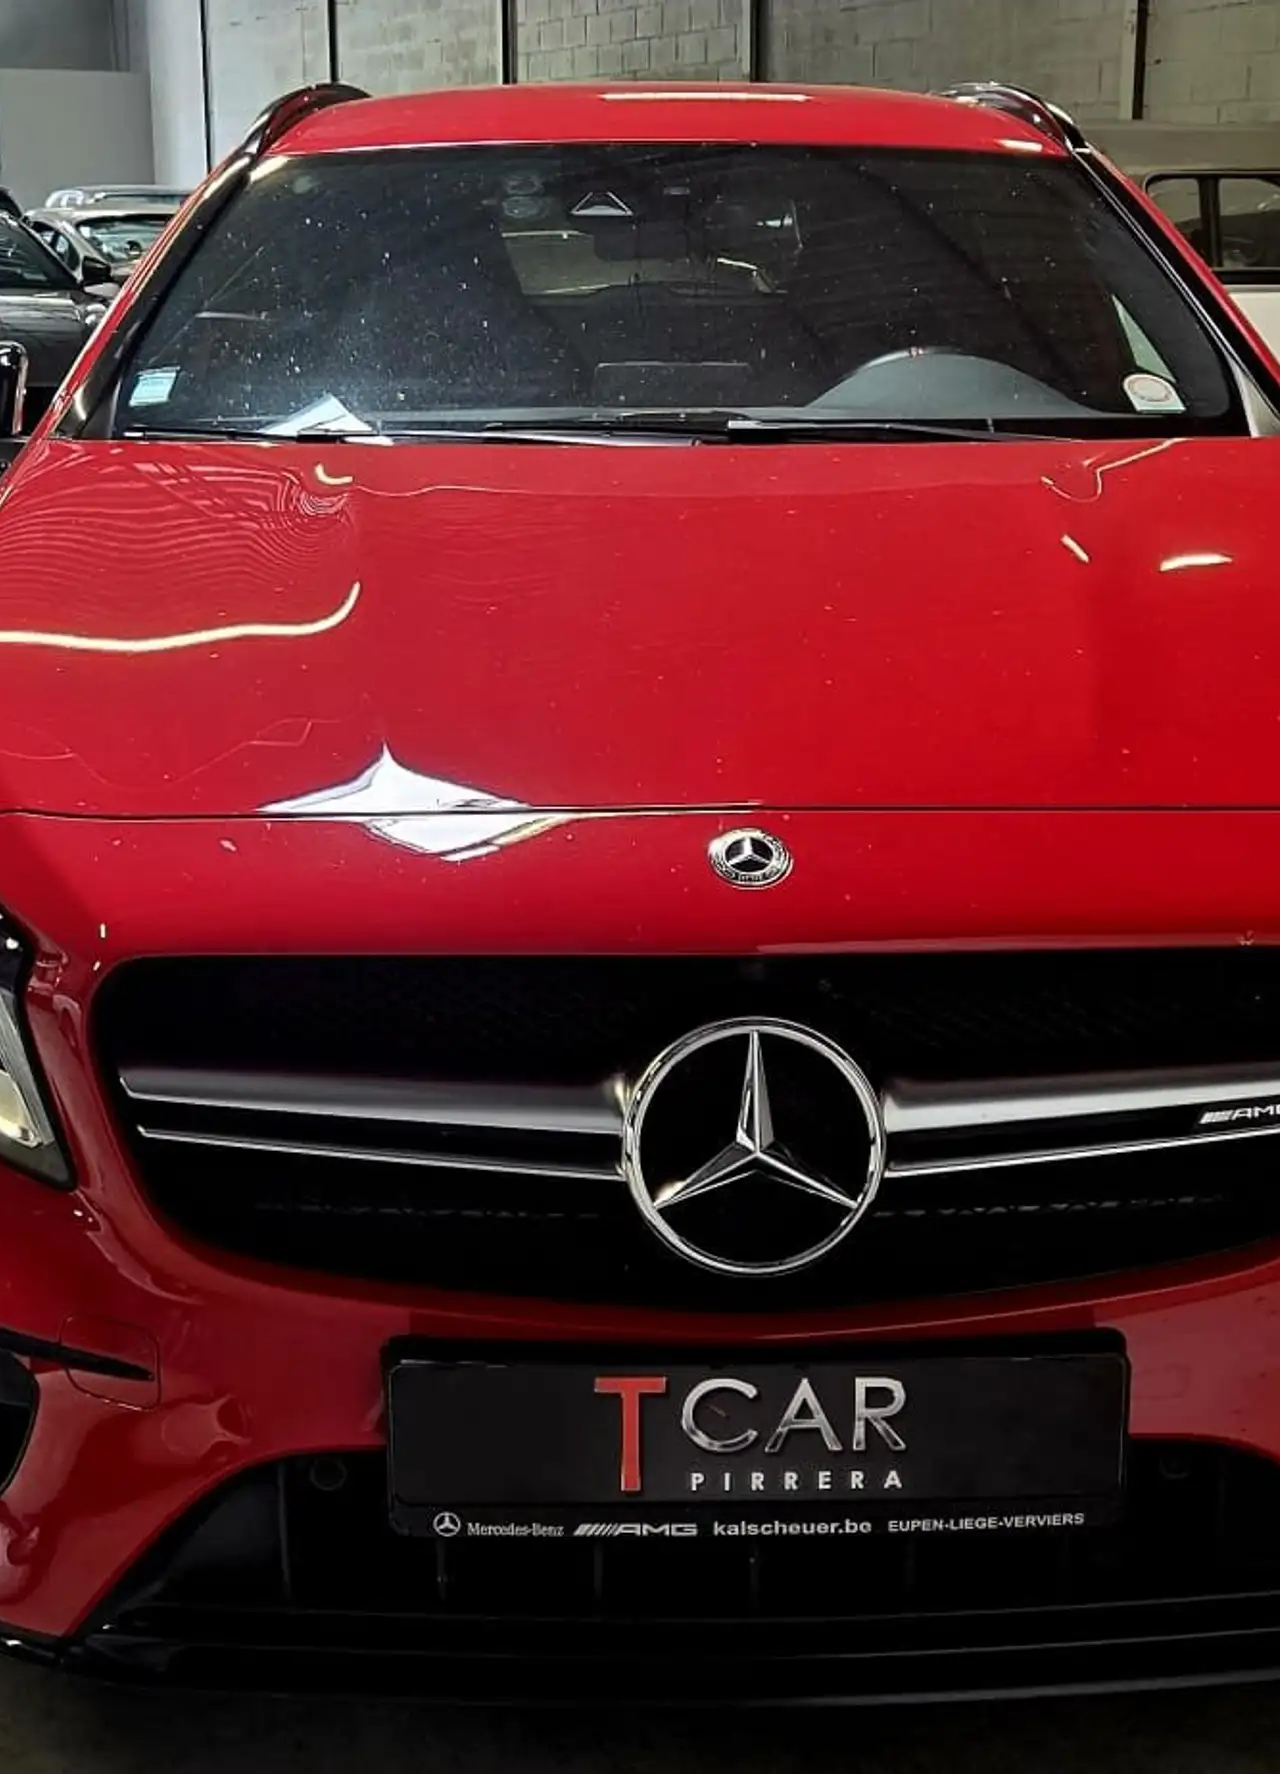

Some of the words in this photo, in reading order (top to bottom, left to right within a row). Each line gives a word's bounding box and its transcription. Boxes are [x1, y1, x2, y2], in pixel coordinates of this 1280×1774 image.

[690, 1470, 903, 1491] PIRRERA
[467, 1522, 564, 1537] Mercedes-Benz
[713, 1519, 873, 1537] kalscheuer.be
